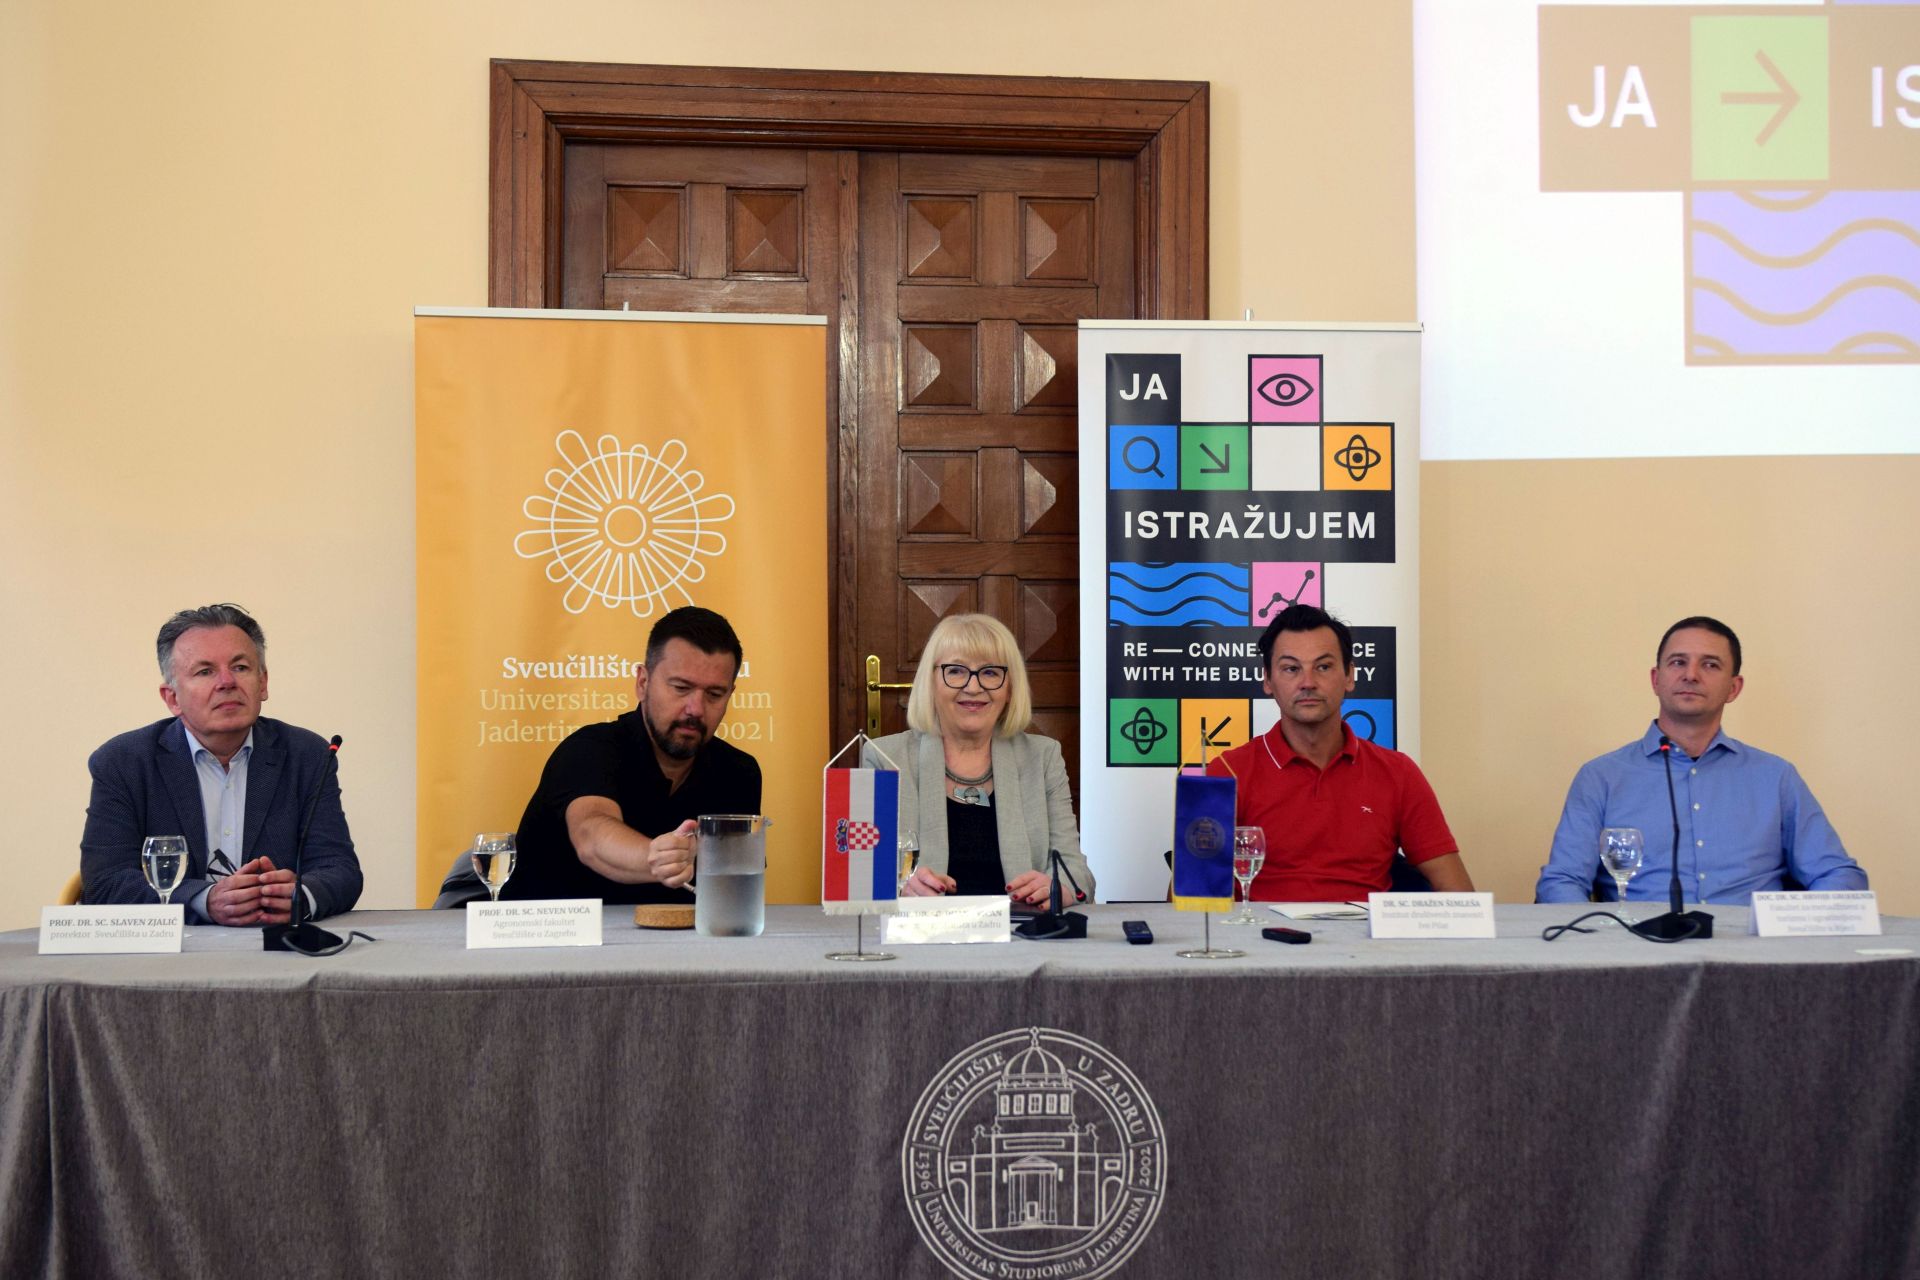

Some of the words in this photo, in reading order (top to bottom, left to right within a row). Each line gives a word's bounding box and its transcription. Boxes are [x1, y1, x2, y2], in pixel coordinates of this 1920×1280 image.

[1567, 65, 1658, 128] JA
[1119, 373, 1168, 401] JA
[1124, 505, 1376, 539] ISTRAŽUJEM
[1123, 643, 1148, 657] RE
[1188, 643, 1264, 657] CONNE
[1123, 667, 1175, 681] WITH
[1183, 667, 1220, 681] THE
[1228, 667, 1265, 681] BLU
[480, 688, 630, 711] Universitas
[49, 919, 75, 927] PROF.
[77, 919, 93, 927] DR.
[95, 918, 109, 926] SC.
[110, 918, 145, 926] SLAVEN
[505, 908, 519, 916] DR.
[536, 907, 566, 915] NEVEN
[50, 930, 91, 940] prorektor
[149, 929, 174, 938] Zadru
[923, 1051, 1006, 1143] SVEUČILIŠTE
[1078, 1055, 1093, 1072] U
[1095, 1069, 1146, 1135] ZADRU
[1139, 1146, 1151, 1187] 2002
